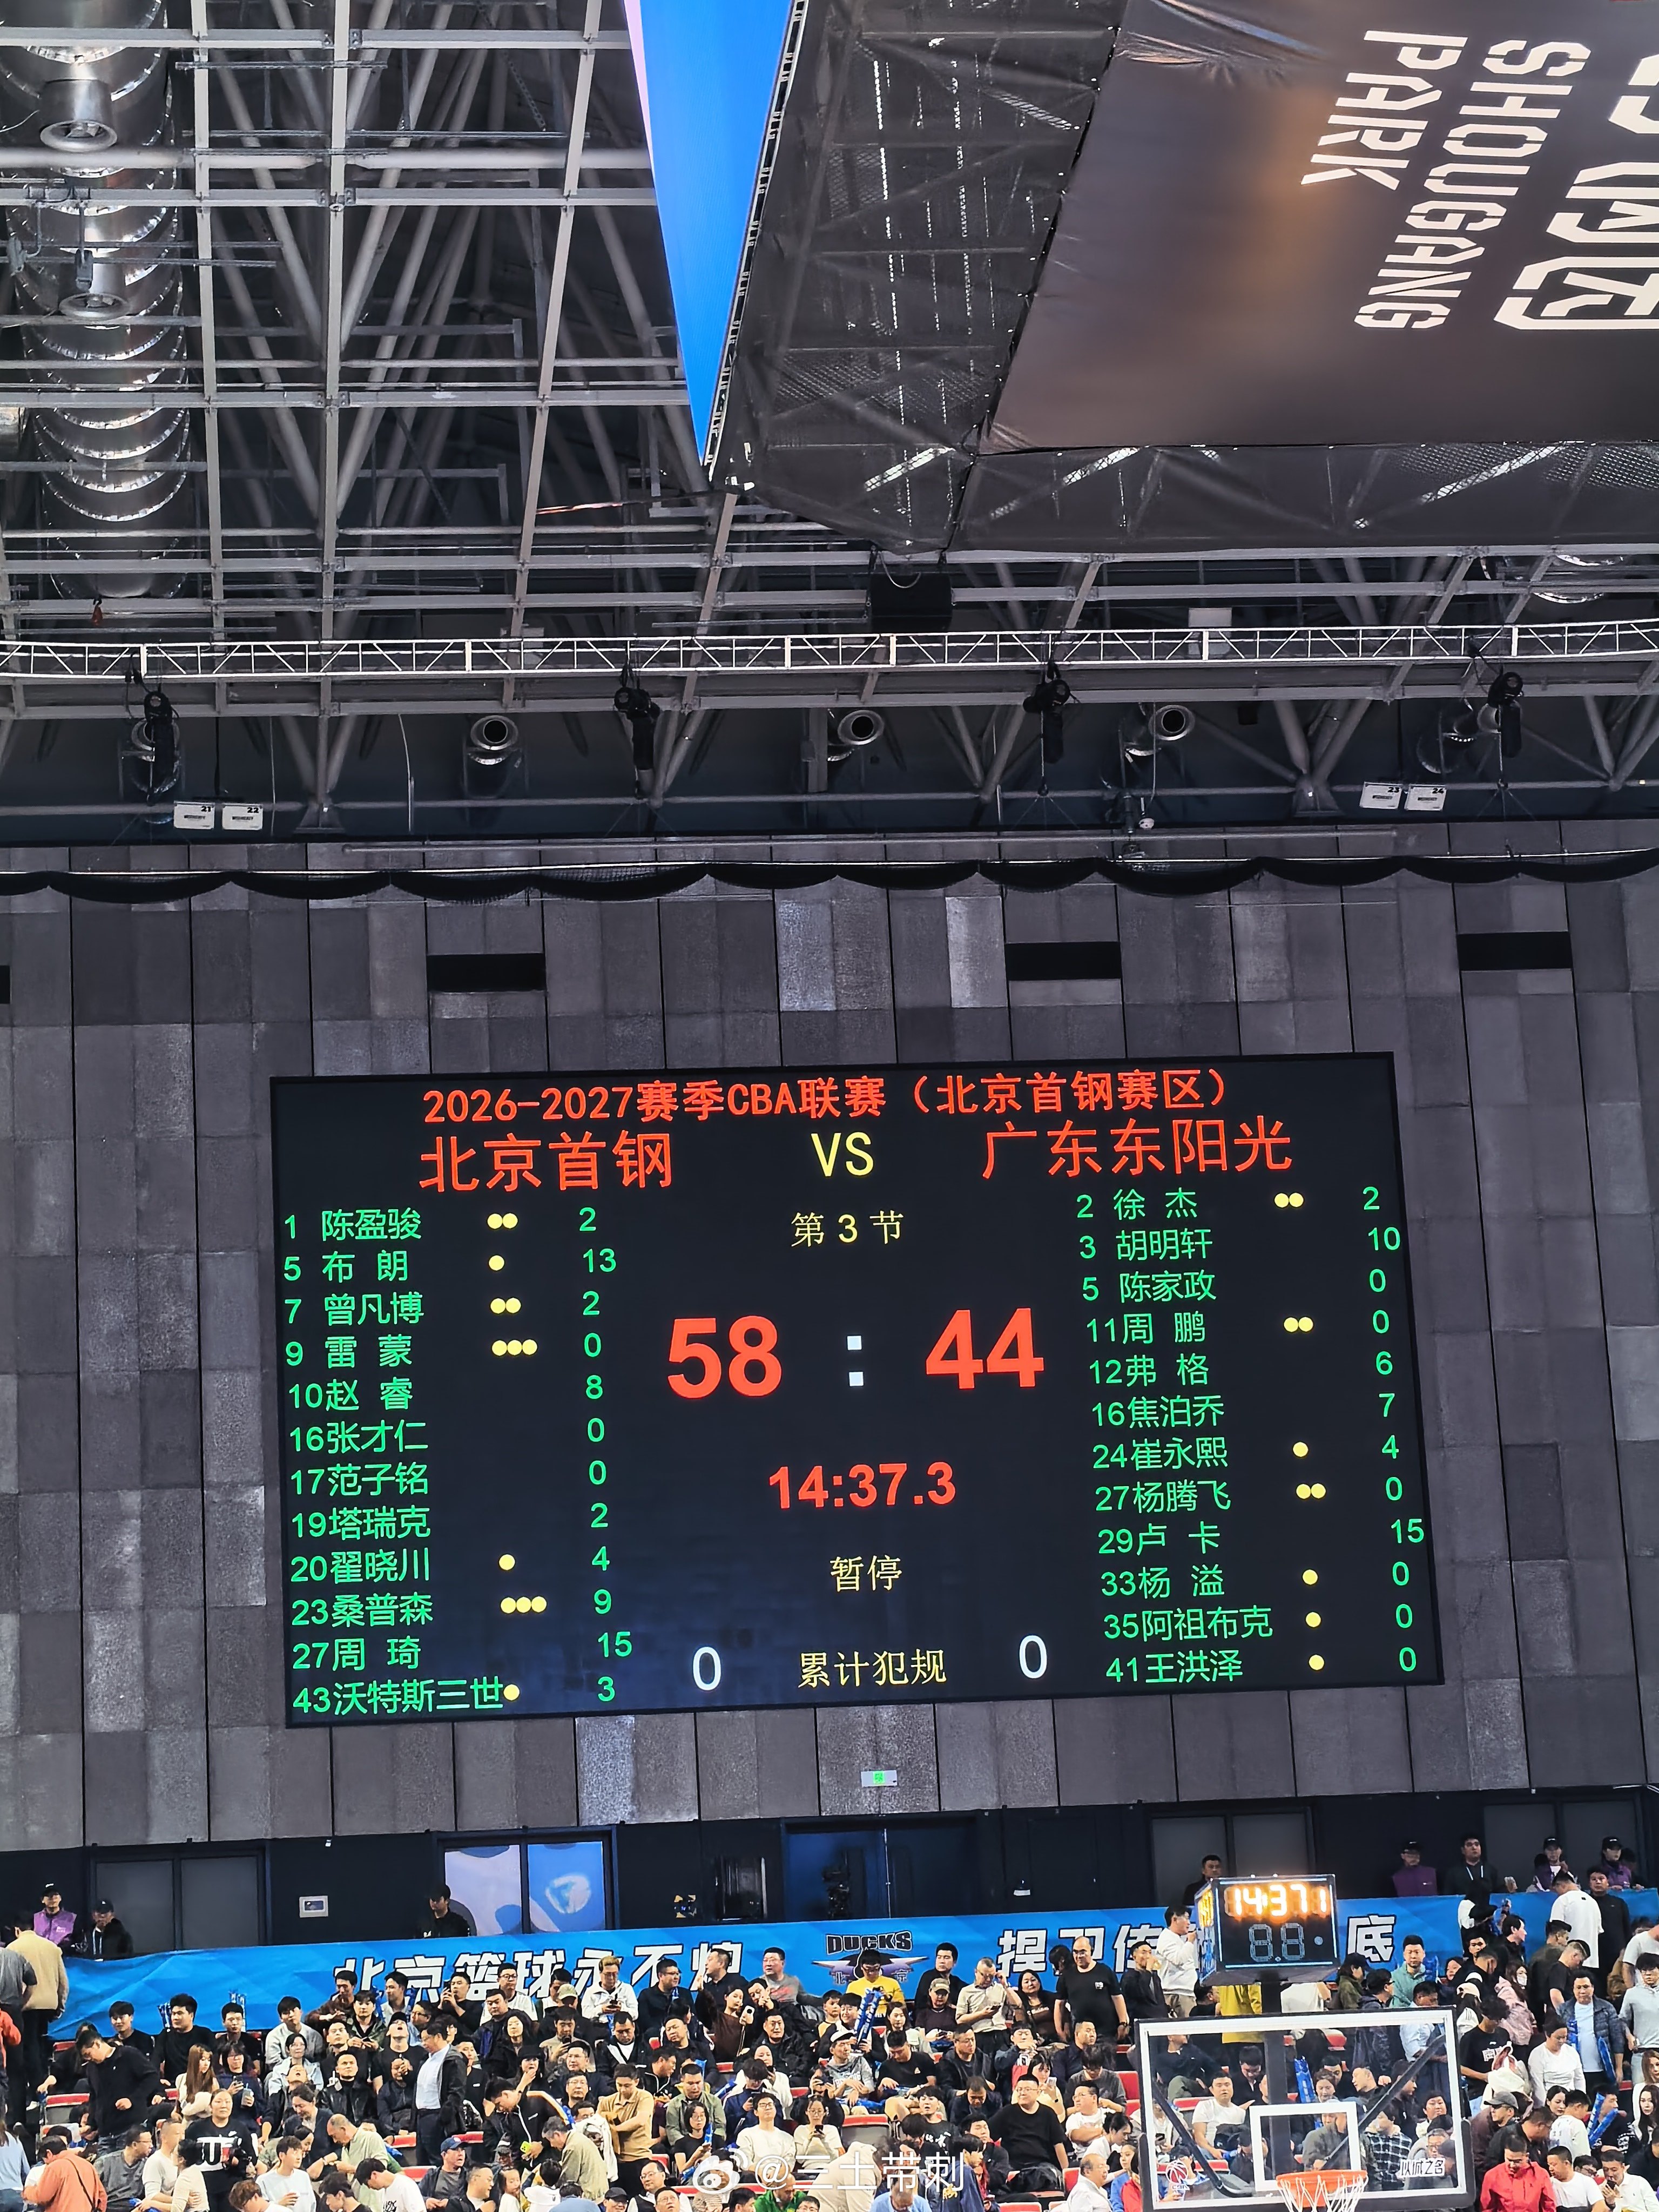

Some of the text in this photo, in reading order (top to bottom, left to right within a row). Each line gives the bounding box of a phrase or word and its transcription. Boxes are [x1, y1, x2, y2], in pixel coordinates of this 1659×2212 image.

[1300, 30, 1468, 190] PARK
[1354, 40, 1591, 329] SHOUGANG
[811, 1131, 874, 1177] VS
[982, 1115, 1292, 1179] 广东东阳光
[419, 1130, 672, 1192] 北京首钢
[1076, 1194, 1094, 1218] 2
[1363, 1186, 1380, 1210] 2
[285, 1207, 596, 1242] 1 陈盈骏 2
[838, 1214, 858, 1243] 3
[1080, 1226, 1400, 1261] 3 胡明轩 10
[284, 1256, 301, 1281] 5
[583, 1248, 616, 1273] 13
[1082, 1269, 1386, 1303] 5 陈家政 0
[285, 1291, 600, 1326] 7 曾凡博 2
[1372, 1310, 1390, 1334] 0
[285, 1341, 303, 1366] 9
[584, 1332, 602, 1358] 0
[667, 1315, 782, 1399] 58
[926, 1307, 1044, 1390] 44
[1375, 1351, 1393, 1375] 6
[585, 1374, 603, 1399] 8
[1379, 1393, 1395, 1418] 7
[587, 1418, 605, 1442] 0
[1381, 1435, 1399, 1459] 4
[589, 1460, 606, 1485] 0
[769, 1461, 956, 1509] 14:37.3
[1385, 1476, 1402, 1501] 0
[590, 1502, 609, 1528] 2
[1391, 1518, 1425, 1543] 15
[591, 1546, 610, 1571] 4
[830, 1555, 902, 1592] 暂停
[1392, 1561, 1410, 1586] 0
[594, 1589, 612, 1614] 9
[1395, 1603, 1413, 1628] 0
[598, 1631, 632, 1658] 15
[693, 1635, 1047, 1691] 0 累计犯规 0
[1399, 1647, 1417, 1672] 0
[597, 1676, 615, 1702] 3
[826, 1930, 913, 1955] DUCKS
